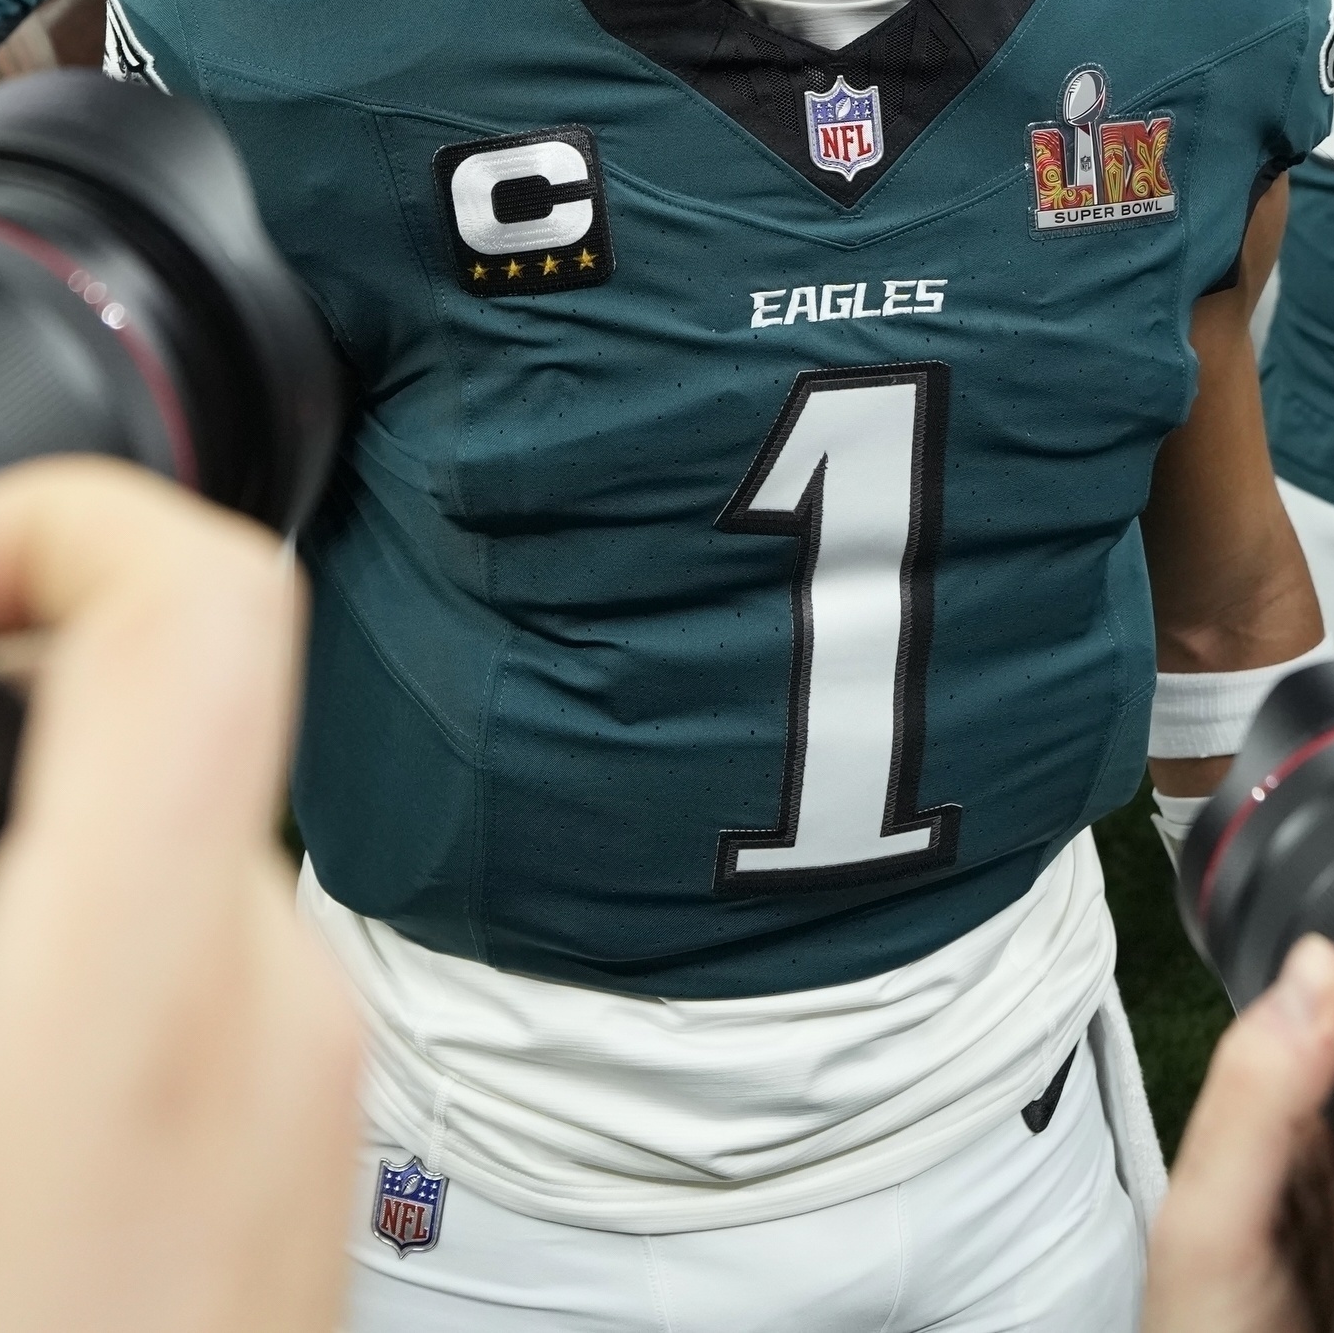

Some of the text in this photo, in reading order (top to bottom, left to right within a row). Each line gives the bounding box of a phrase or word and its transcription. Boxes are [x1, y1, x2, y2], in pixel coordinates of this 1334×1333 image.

[820, 124, 873, 163] NFL
[1031, 117, 1172, 212] LIX
[451, 140, 594, 257] C
[1054, 200, 1163, 224] SUPER BOWL
[750, 279, 949, 329] EAGLES
[714, 360, 962, 896] 1
[379, 1197, 429, 1242] NFL
